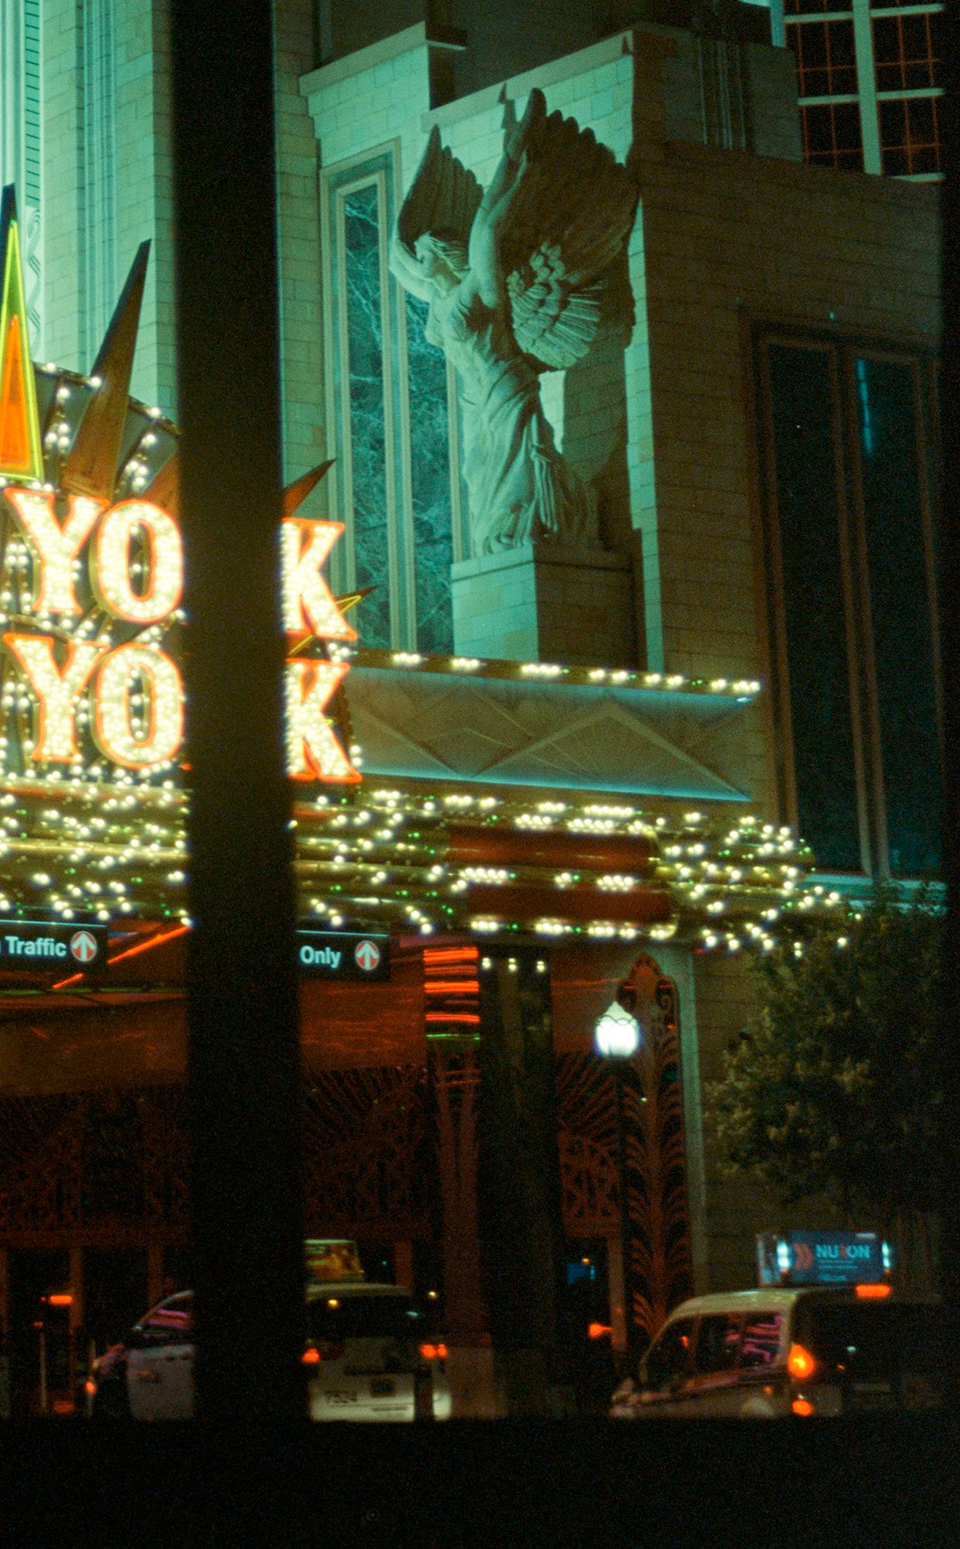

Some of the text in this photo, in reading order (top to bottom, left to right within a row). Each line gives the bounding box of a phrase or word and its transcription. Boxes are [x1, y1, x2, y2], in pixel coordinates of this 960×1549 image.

[3, 486, 358, 642] YOK
[3, 633, 362, 783] YOK
[5, 935, 67, 957] Traffic
[300, 945, 341, 969] Only
